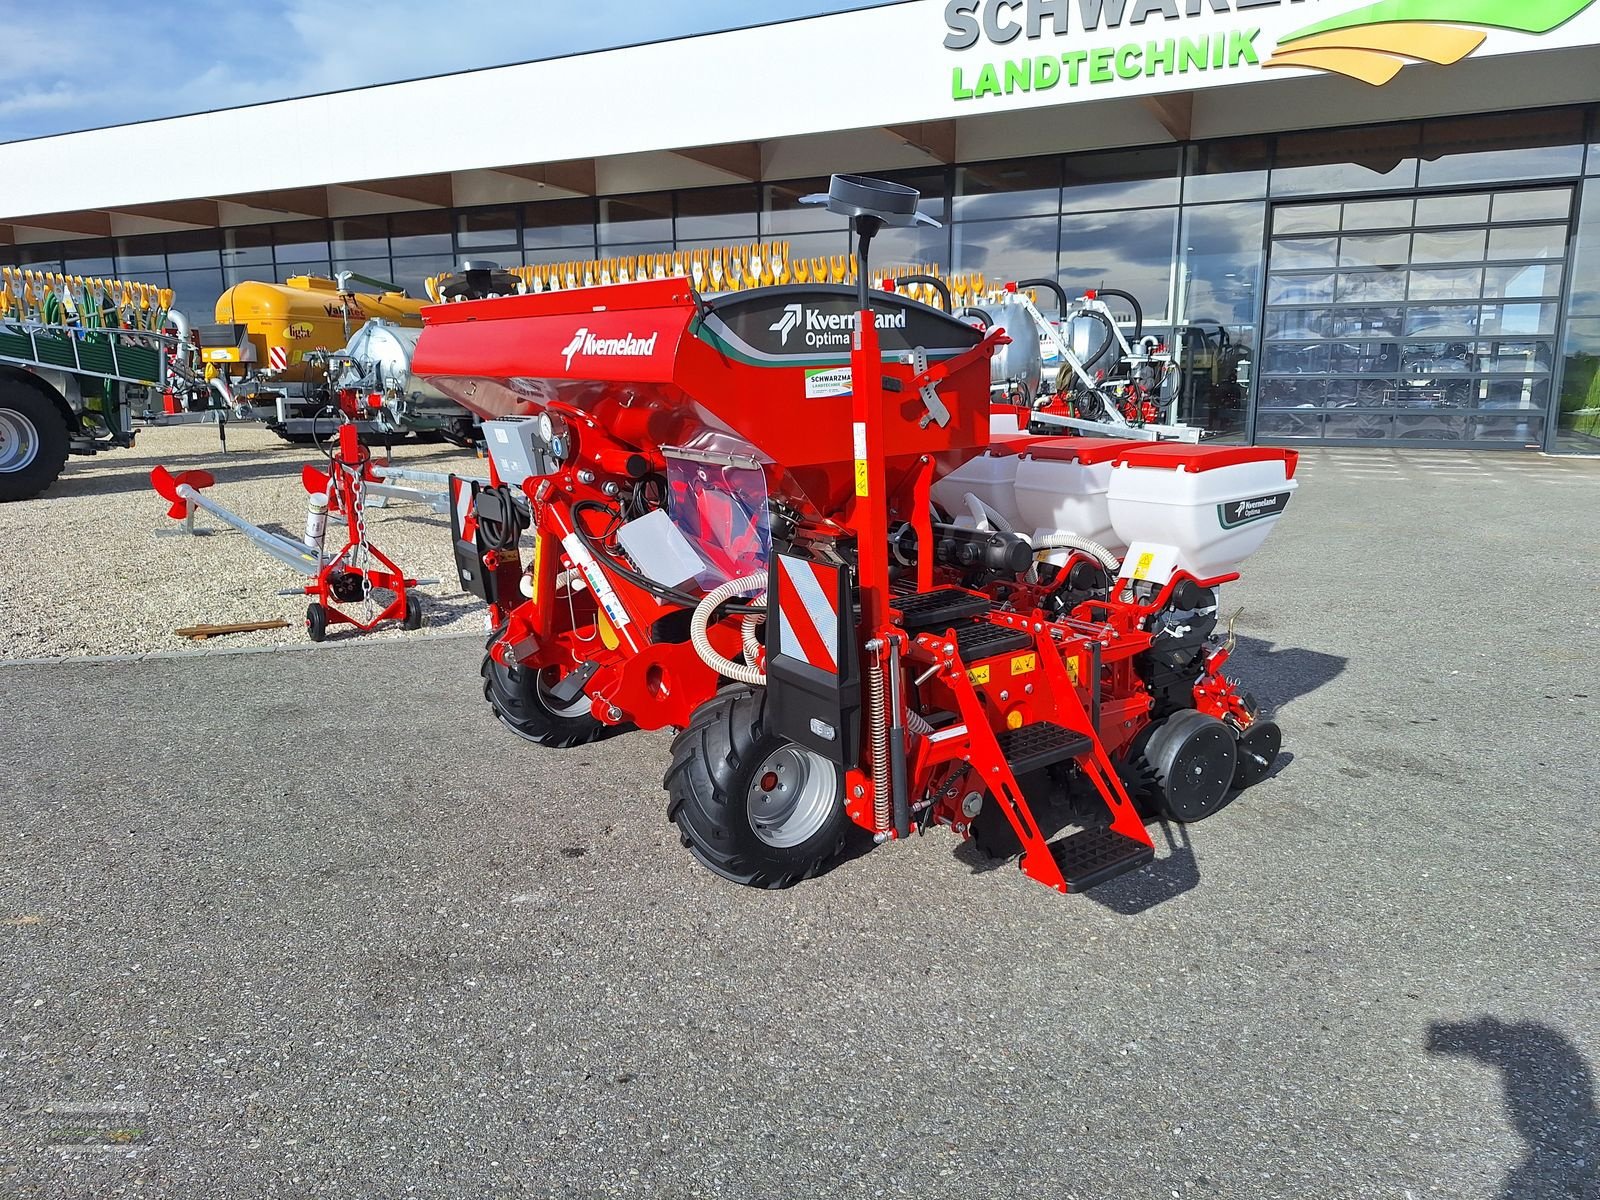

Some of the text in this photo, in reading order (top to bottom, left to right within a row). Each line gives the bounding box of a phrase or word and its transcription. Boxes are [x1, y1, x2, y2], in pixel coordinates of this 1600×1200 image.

[943, 0, 1306, 50] SCHW
[952, 27, 1260, 100] LANDTECHNIK
[805, 309, 906, 330] Kverand
[582, 332, 658, 355] Kverneland
[805, 332, 850, 348] Optima
[1244, 509, 1260, 517] Optima
[1245, 497, 1276, 509] Kverneland
